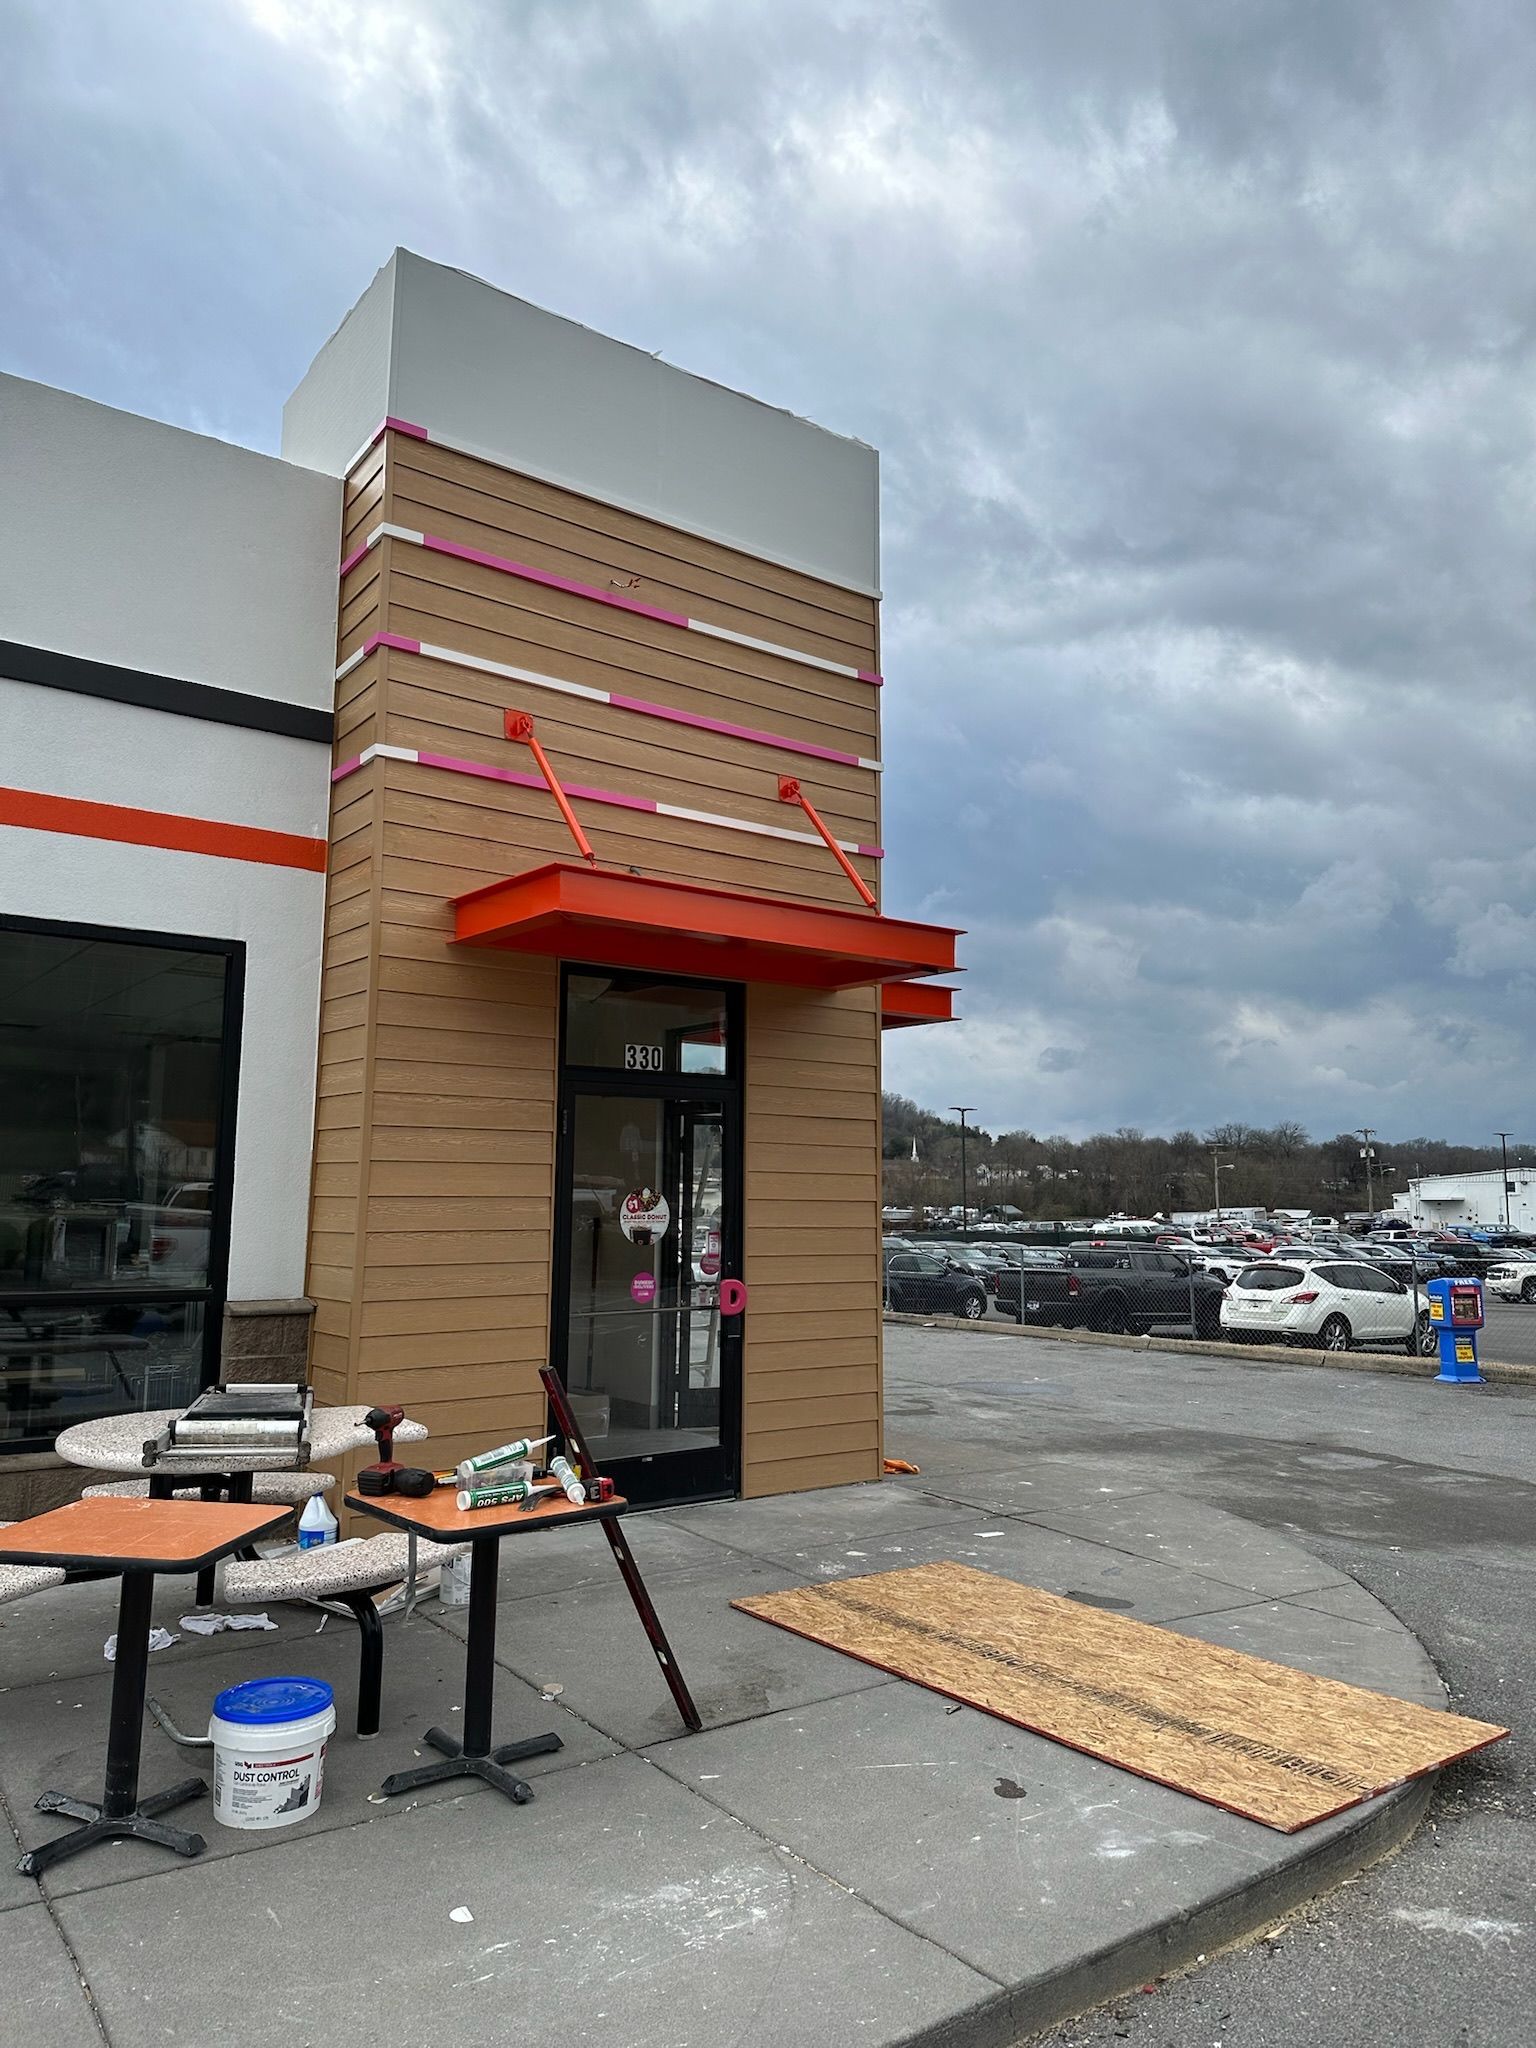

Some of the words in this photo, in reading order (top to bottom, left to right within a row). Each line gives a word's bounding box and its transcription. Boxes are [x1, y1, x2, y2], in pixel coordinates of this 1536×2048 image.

[627, 1045, 661, 1070] 330
[627, 1199, 639, 1210] $1
[477, 1497, 498, 1507] 500
[501, 1493, 524, 1504] APS
[233, 1770, 256, 1782] DUST
[257, 1768, 300, 1782] CONTROL
